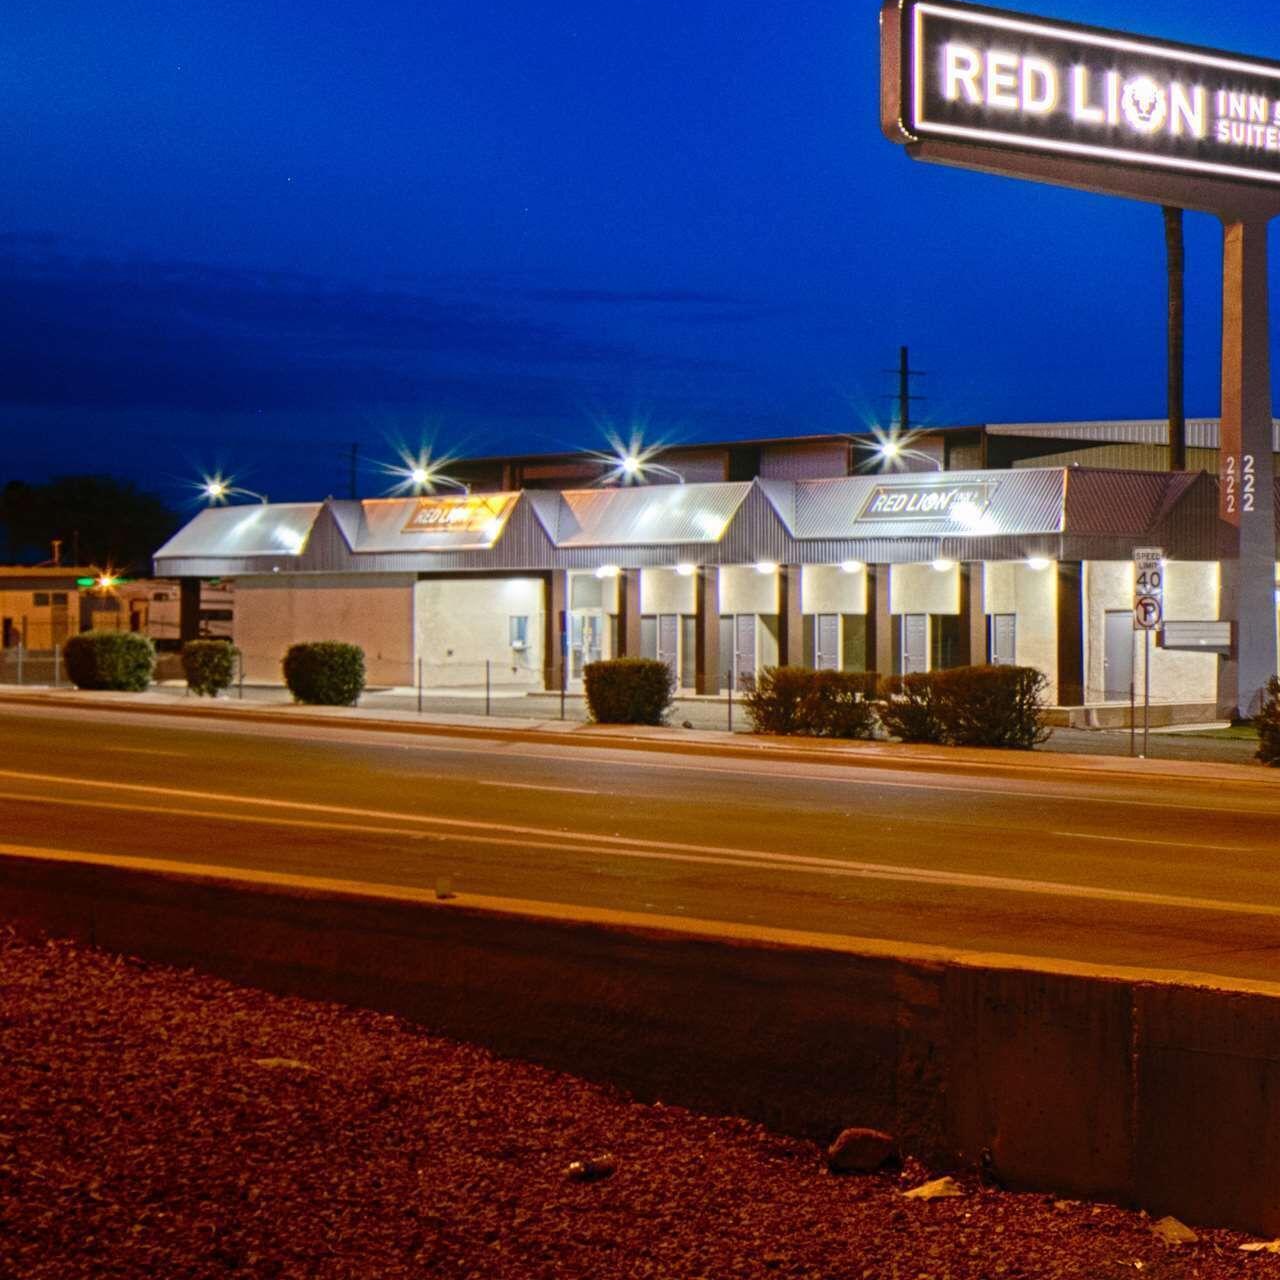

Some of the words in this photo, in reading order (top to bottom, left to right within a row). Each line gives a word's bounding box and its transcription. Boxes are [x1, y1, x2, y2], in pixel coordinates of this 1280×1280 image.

[944, 43, 1057, 113] RED
[1072, 65, 1206, 138] LION
[1217, 90, 1268, 120] INN
[870, 494, 908, 512] RED
[904, 491, 954, 512] LION
[1136, 552, 1161, 560] SPEED
[1136, 571, 1161, 588] 40
